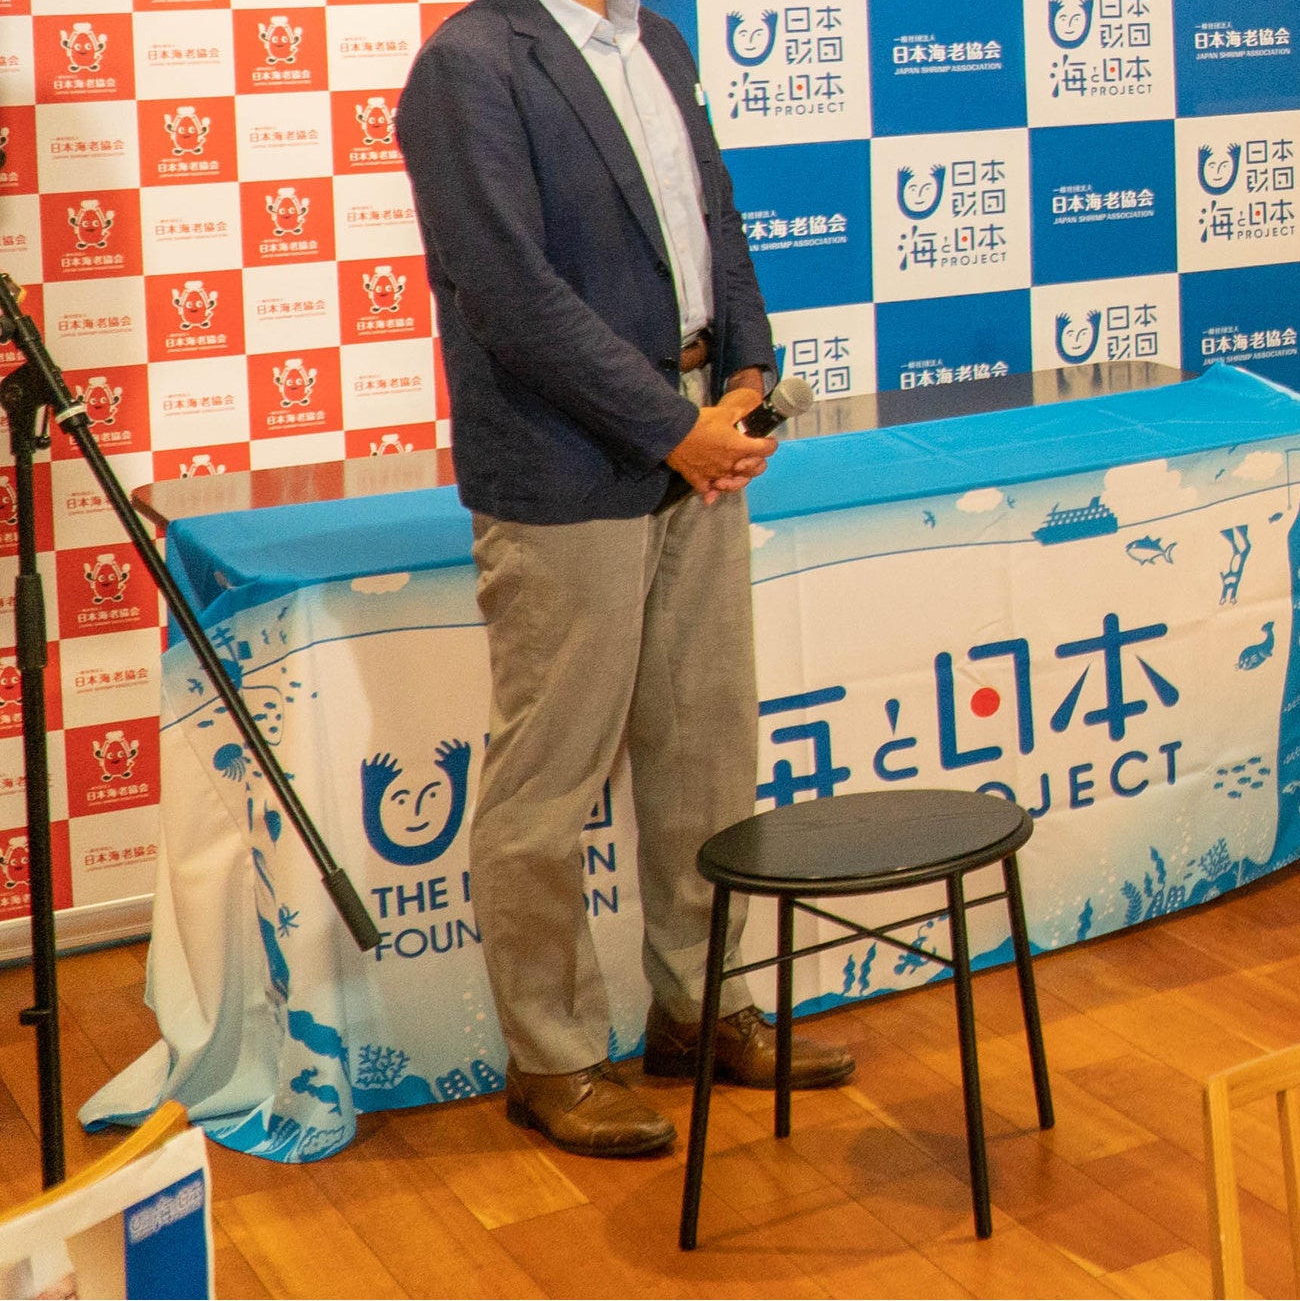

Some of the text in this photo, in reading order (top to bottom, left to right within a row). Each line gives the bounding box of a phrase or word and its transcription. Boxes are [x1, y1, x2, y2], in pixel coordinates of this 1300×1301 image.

[784, 5, 842, 34] 日本
[1100, 22, 1151, 49] 財団
[1194, 27, 1290, 50] 日本海老協会
[785, 36, 844, 65] 財団
[892, 40, 1002, 64] 日本海老協会
[1049, 53, 1152, 99] 海と日本
[1090, 83, 1153, 96] PROJECT
[728, 71, 844, 120] 海と日本
[774, 101, 845, 116] PROJECT
[1245, 138, 1294, 165] 日本
[951, 159, 1005, 187] 日本
[1246, 166, 1295, 193] 財団
[952, 188, 1006, 218] 財団
[1052, 188, 1155, 214] 日本海老協会
[1198, 198, 1295, 244] 海と日本
[1237, 225, 1295, 240] PROJECT
[898, 223, 1007, 271] 海と日本
[941, 251, 1007, 267] PROJECT
[58, 315, 131, 332] 日本海老協会
[1201, 327, 1297, 355] 日本海老協会
[163, 394, 233, 410] 日本海老協会
[266, 410, 325, 425] 日本海老協会
[75, 667, 148, 688] 日本海老協会
[84, 844, 157, 867] 日本海老協会
[371, 877, 448, 919] THE
